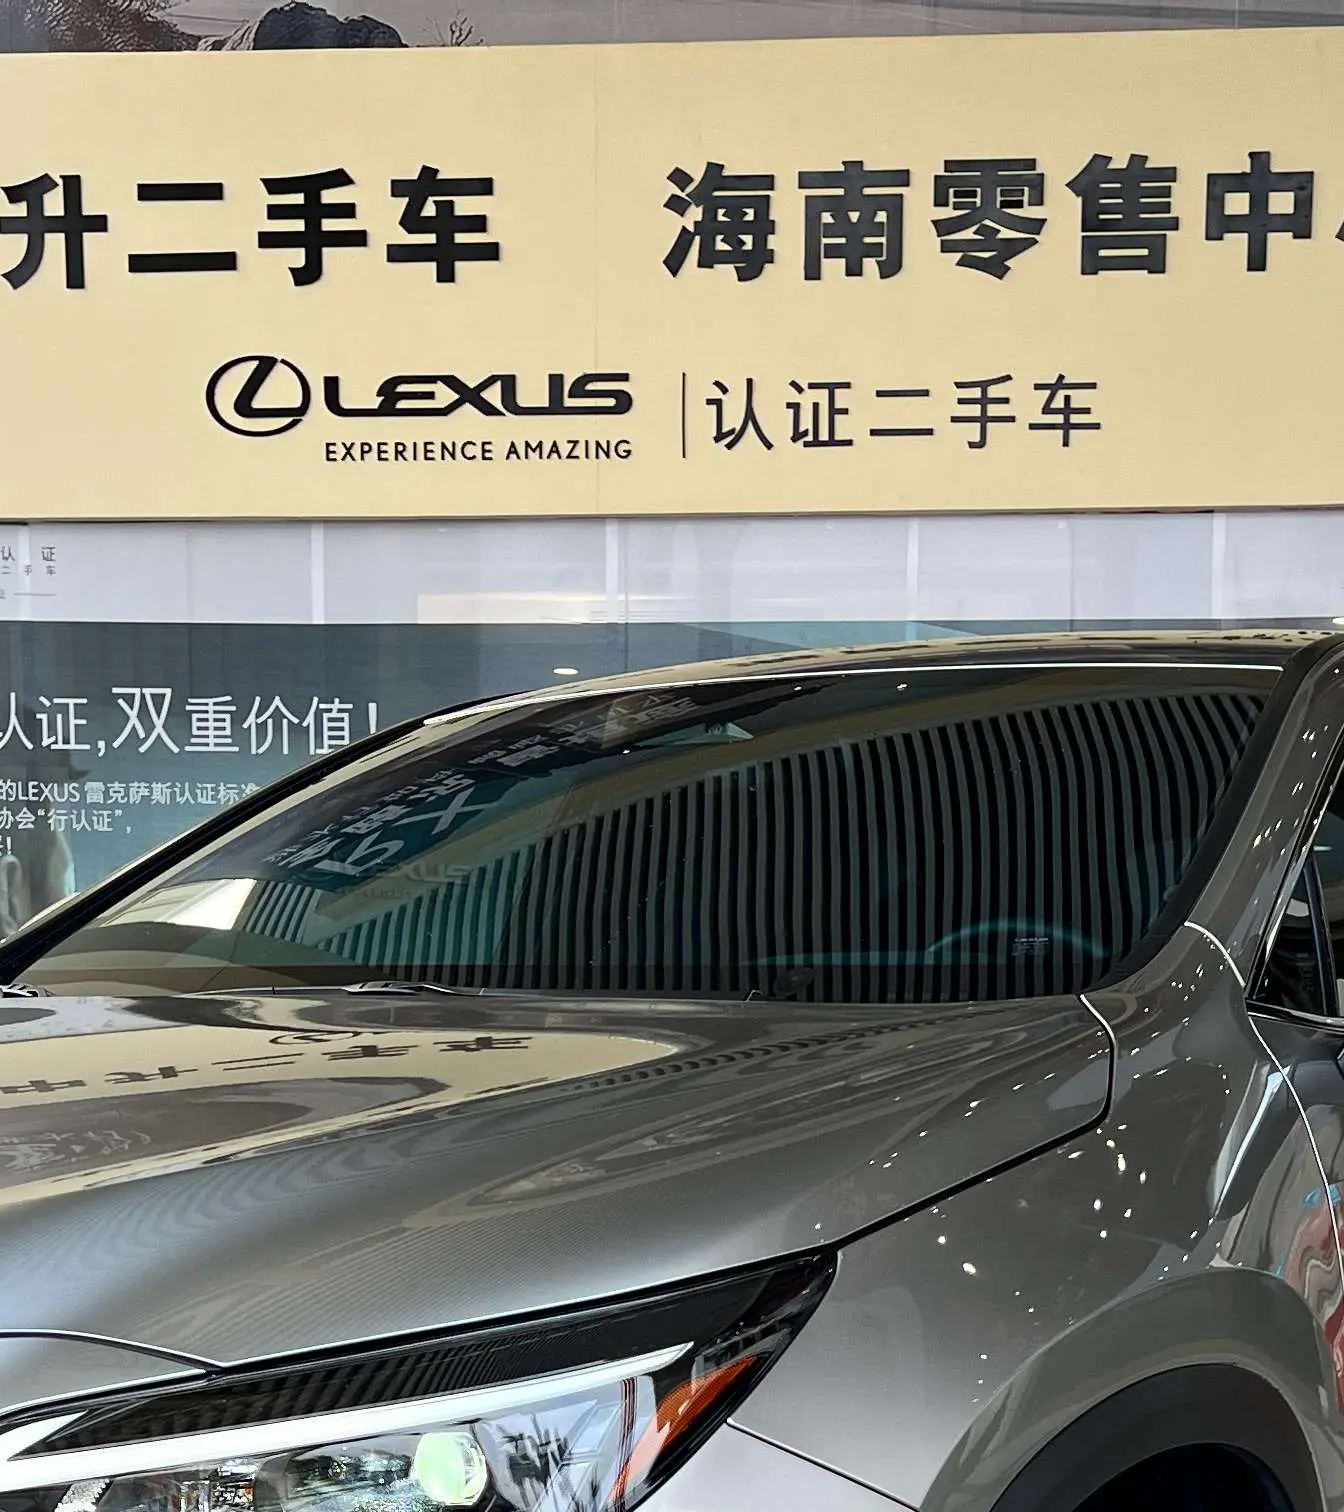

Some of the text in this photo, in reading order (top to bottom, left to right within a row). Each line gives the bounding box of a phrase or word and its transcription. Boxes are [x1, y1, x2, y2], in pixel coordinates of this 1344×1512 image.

[323, 372, 1103, 452] LEXUS 认证二手车
[325, 439, 633, 463] EXPERIENCE AMAZING
